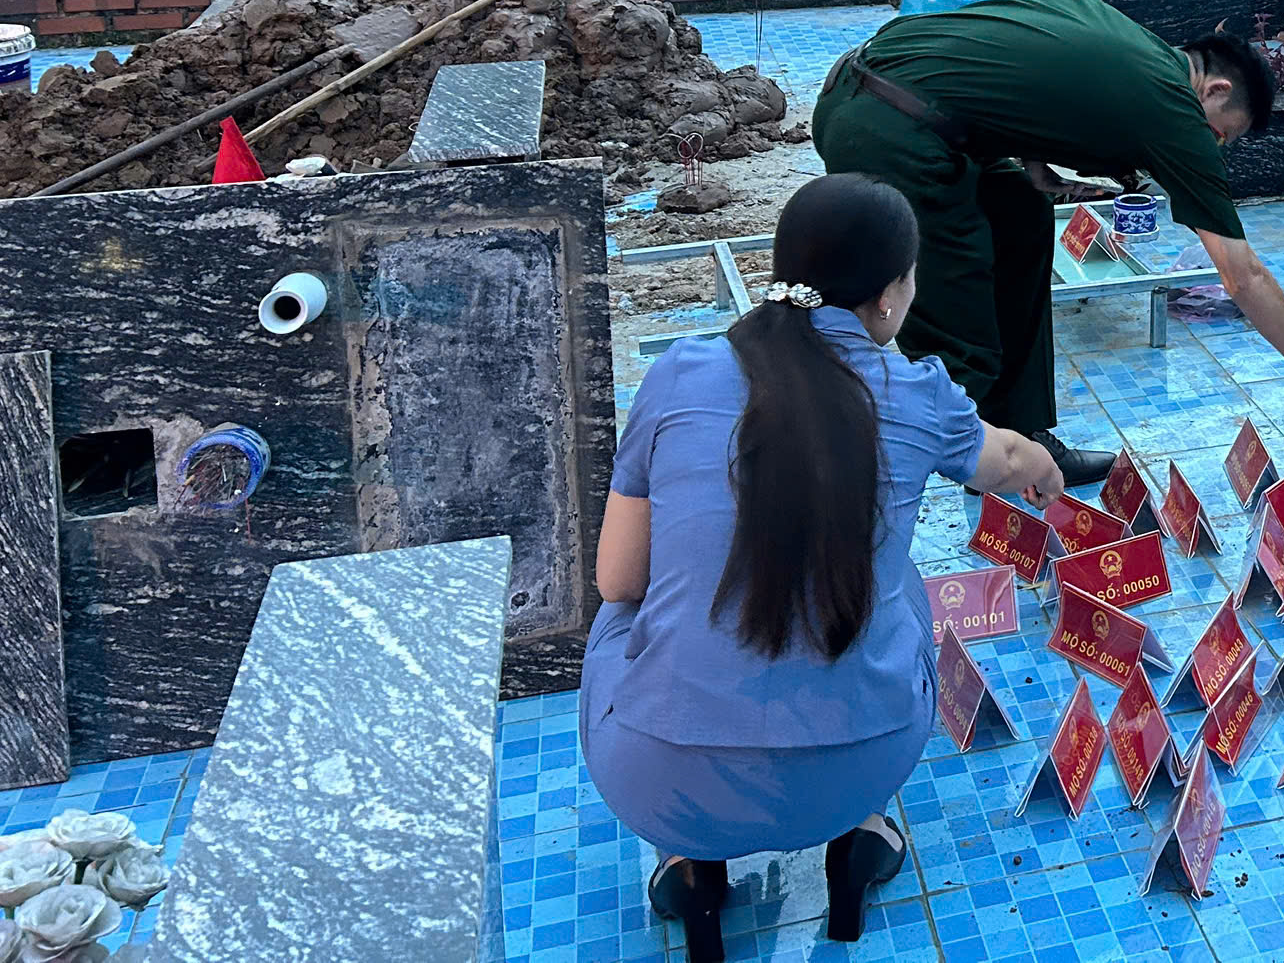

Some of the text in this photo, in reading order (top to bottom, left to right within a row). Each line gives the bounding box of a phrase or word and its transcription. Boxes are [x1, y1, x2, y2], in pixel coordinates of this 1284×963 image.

[978, 531, 1036, 570] MỘ SỐ: 00107
[1123, 575, 1160, 594] 00050
[963, 611, 1005, 629] 00101
[1060, 630, 1131, 677] MỘ SỐ: 00061
[1224, 637, 1245, 667] 00043
[1234, 691, 1254, 723] 00046
